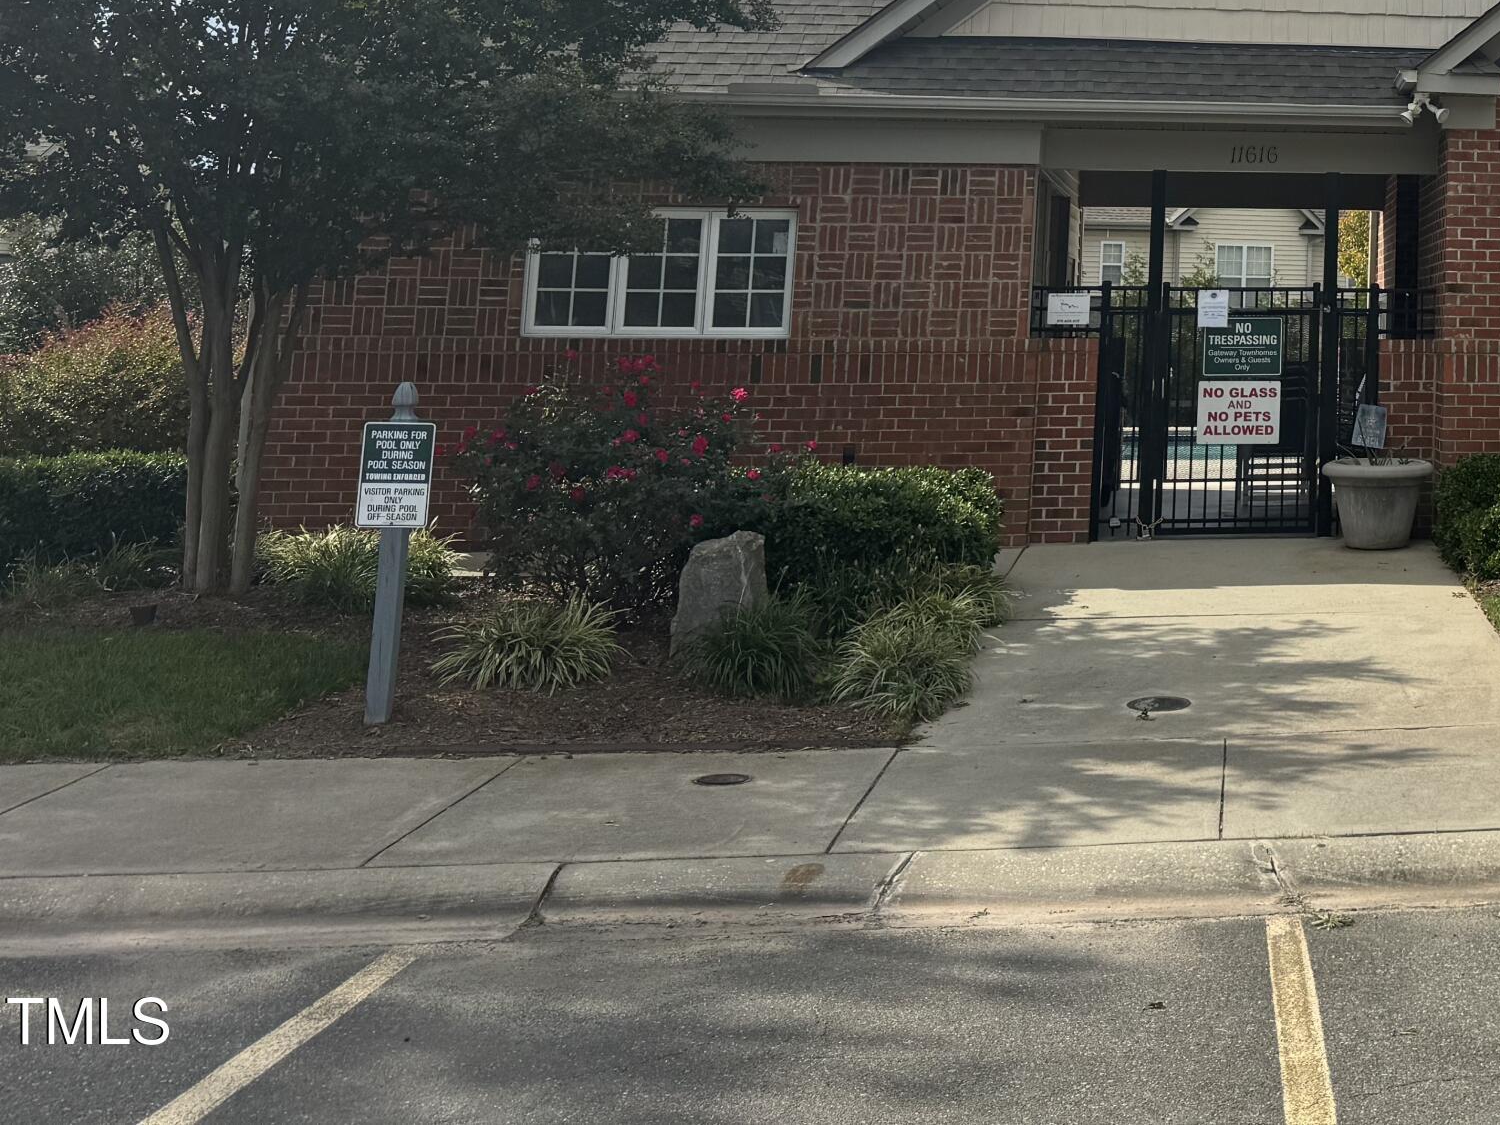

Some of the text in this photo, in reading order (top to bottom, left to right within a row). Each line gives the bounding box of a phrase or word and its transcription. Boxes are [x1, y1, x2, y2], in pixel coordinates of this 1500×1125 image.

[1230, 146, 1278, 163] 11616
[1235, 323, 1251, 333] NO
[1208, 335, 1277, 344] TRESPASSING
[1203, 388, 1277, 398] NO GLASS
[1228, 400, 1251, 409] AND
[1208, 412, 1271, 421] NO PETS
[1203, 425, 1274, 435] ALLOWED
[371, 430, 427, 440] PARKING FOR
[376, 440, 421, 450] POOL ONLY
[382, 451, 413, 459] DURING
[367, 461, 425, 469] POOL SEASON
[394, 488, 425, 496] PARKING
[384, 496, 403, 504] ONLY
[367, 504, 396, 512] DURING
[367, 513, 417, 521] OFF-SEASON
